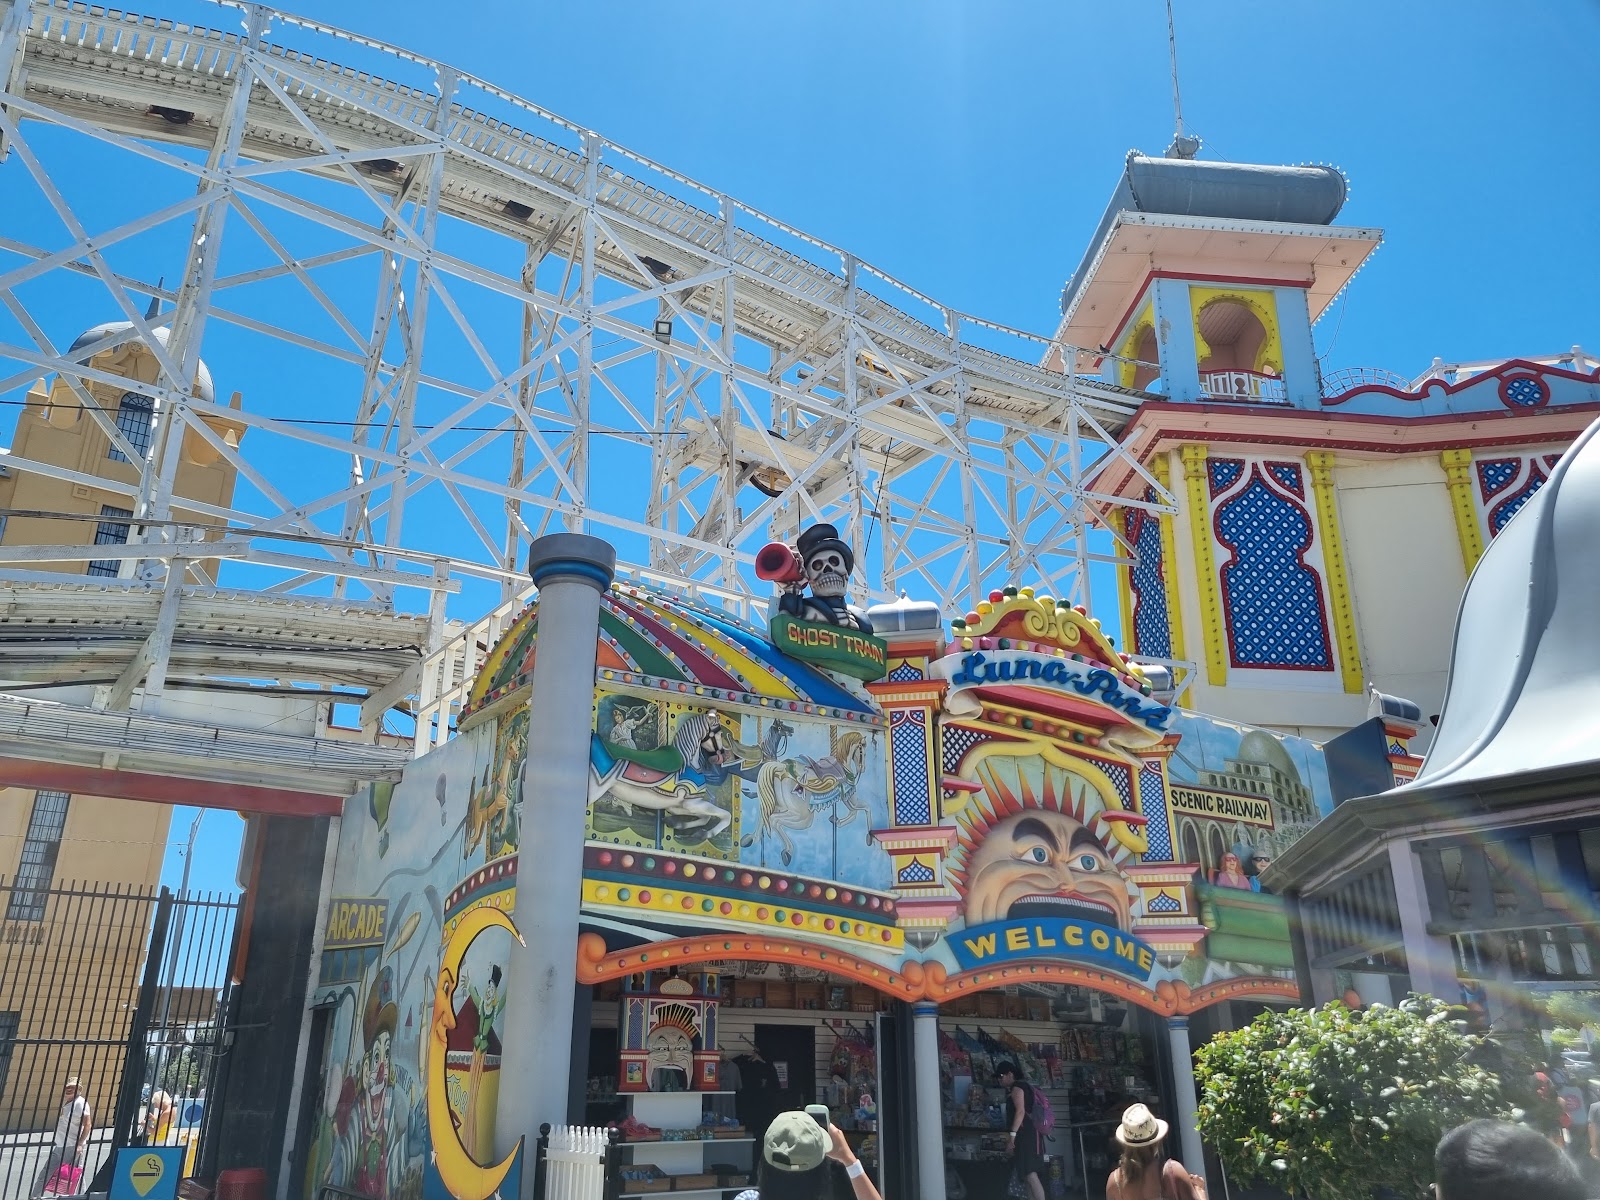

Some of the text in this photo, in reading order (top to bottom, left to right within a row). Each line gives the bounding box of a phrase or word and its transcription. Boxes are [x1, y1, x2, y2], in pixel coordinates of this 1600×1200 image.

[787, 622, 884, 665] GHOST TRAIN
[952, 651, 1171, 731] Luna Park
[1170, 789, 1268, 821] SCENIC RAILWAY
[325, 902, 386, 940] ARCADE
[964, 925, 1153, 972] WELCOME
